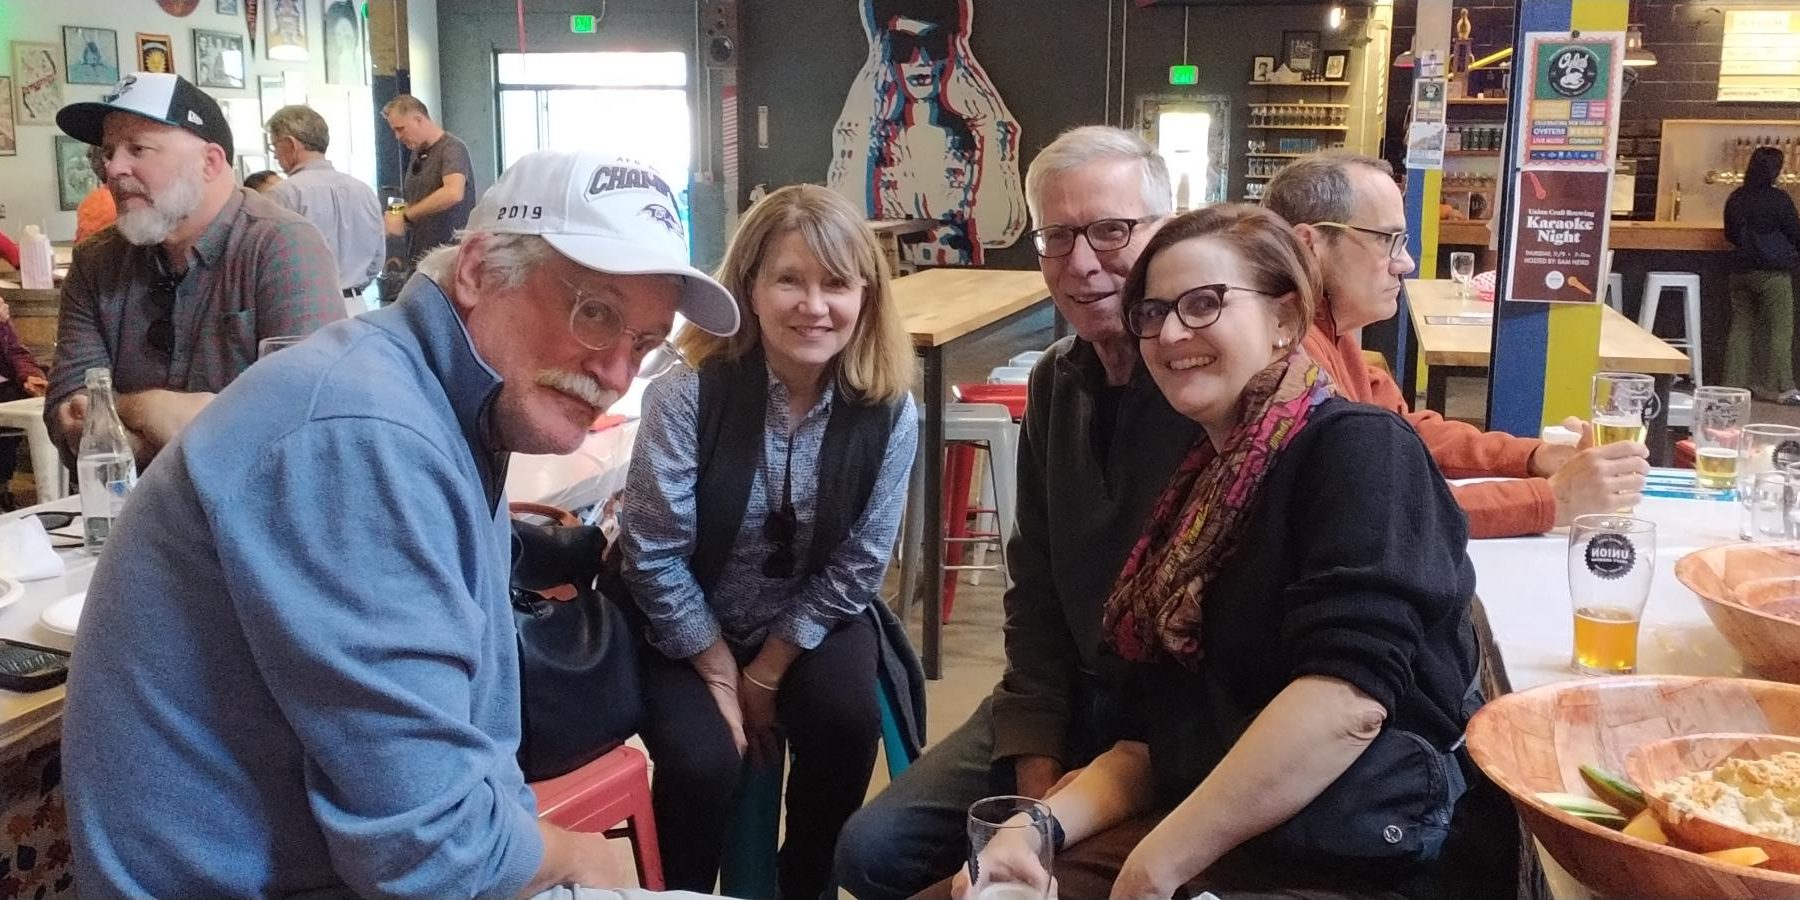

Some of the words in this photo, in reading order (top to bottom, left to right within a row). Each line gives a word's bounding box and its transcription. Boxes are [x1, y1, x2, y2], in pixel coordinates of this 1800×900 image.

[497, 204, 542, 220] 2019
[1548, 208, 1566, 216] Craft
[1566, 209, 1595, 218] Brewing
[1527, 215, 1595, 231] Karaoke
[1537, 229, 1581, 246] Night
